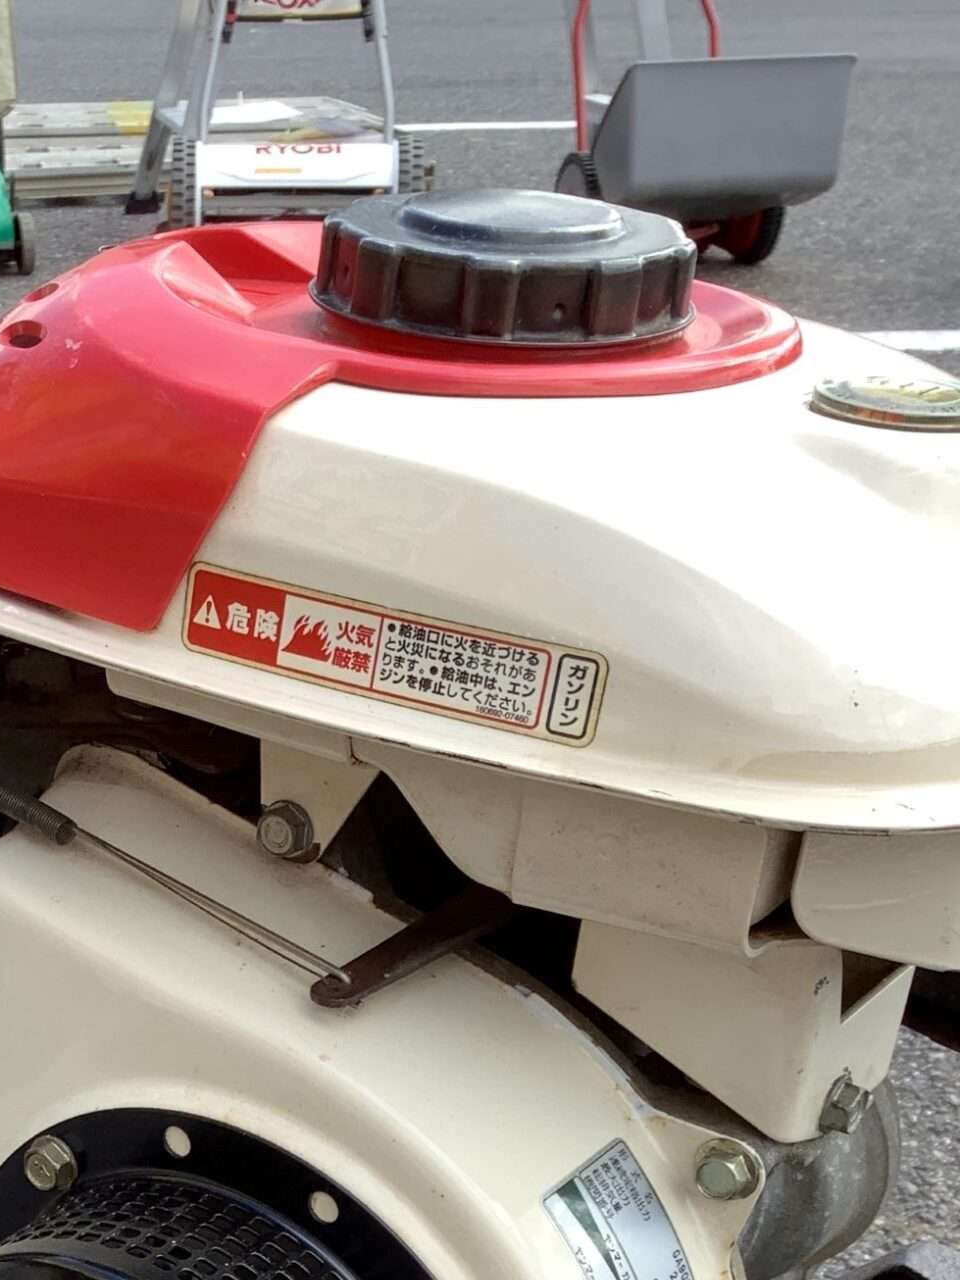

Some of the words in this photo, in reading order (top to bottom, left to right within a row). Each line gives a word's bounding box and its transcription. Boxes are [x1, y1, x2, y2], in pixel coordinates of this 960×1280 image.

[226, 602, 280, 642] 危険
[336, 620, 376, 649] 火気
[331, 646, 372, 674] 厳禁
[383, 639, 537, 682] と火災になるおそれがあ
[398, 623, 540, 666] 給油口に火を近づける
[559, 664, 589, 727] ガソリン
